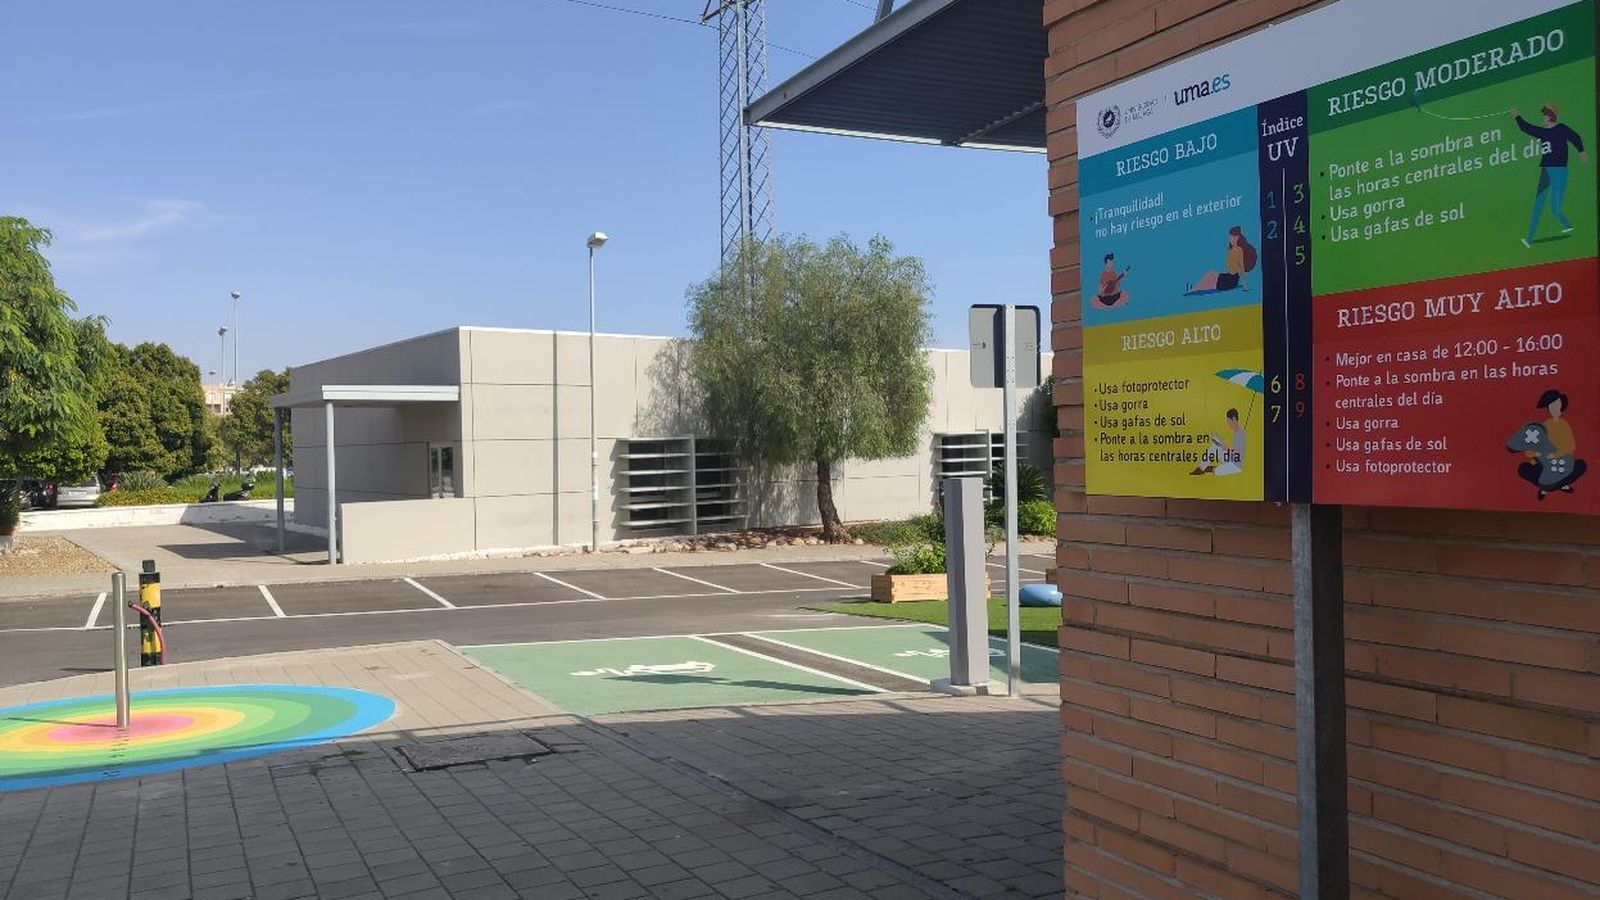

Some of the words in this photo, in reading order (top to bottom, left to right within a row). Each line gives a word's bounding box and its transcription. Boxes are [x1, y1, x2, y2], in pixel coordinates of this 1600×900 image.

[1327, 78, 1406, 117] RIESGO
[1414, 28, 1565, 94] MODERADO
[1174, 74, 1230, 105] uma.es
[1262, 116, 1303, 137] Índice
[1115, 148, 1169, 177] RIESGO
[1175, 134, 1217, 160] BAJO
[1267, 137, 1299, 161] UV
[1328, 156, 1369, 181] Ponte
[1375, 157, 1384, 170] a
[1390, 150, 1404, 167] la
[1410, 135, 1473, 161] sombra
[1480, 128, 1502, 145] en
[1329, 183, 1351, 201] las
[1356, 174, 1400, 195] horas
[1405, 155, 1483, 185] centrales
[1488, 144, 1516, 166] del
[1522, 137, 1552, 159] día
[1267, 191, 1276, 209] 1
[1293, 184, 1304, 204] 3
[1095, 192, 1164, 225] ¡Tranquilidad!
[1095, 227, 1107, 238] no
[1110, 223, 1127, 240] hay
[1131, 215, 1163, 231] riesgo
[1166, 212, 1178, 221] en
[1182, 204, 1192, 219] el
[1196, 195, 1242, 215] exterior
[1330, 204, 1358, 221] Usa
[1363, 196, 1405, 218] gorra
[1266, 220, 1278, 240] 2
[1293, 215, 1306, 234] 4
[1330, 225, 1358, 242] Usa
[1364, 215, 1409, 240] gafas
[1414, 209, 1434, 228] de
[1440, 202, 1465, 222] sol
[1295, 245, 1305, 265] 5
[1337, 301, 1416, 329] RIESGO
[1424, 292, 1485, 318] MUY
[1495, 281, 1563, 310] ALTO
[1121, 330, 1175, 351] RIESGO
[1181, 324, 1221, 345] ALTO
[1336, 352, 1372, 368] Mejor
[1376, 352, 1392, 363] en
[1396, 349, 1427, 362] casa
[1432, 345, 1449, 360] de
[1454, 339, 1498, 358] 12:00
[1516, 333, 1563, 353] 16:00
[1271, 374, 1281, 393] 6
[1295, 373, 1305, 390] 8
[1336, 374, 1370, 388] Ponte
[1373, 375, 1382, 386] a
[1386, 371, 1399, 385] la
[1403, 367, 1456, 384] sombra
[1460, 368, 1478, 380] en
[1484, 364, 1507, 379] las
[1512, 362, 1558, 377] horas
[1099, 382, 1118, 395] Usa
[1122, 379, 1190, 395] fotoprotector
[1100, 400, 1118, 412] Usa
[1122, 401, 1148, 413] gorra
[1295, 401, 1305, 418] 9
[1335, 393, 1393, 409] centrales
[1397, 392, 1418, 406] del
[1422, 391, 1443, 405] día
[1100, 416, 1118, 427] Usa
[1122, 415, 1150, 430] gafas
[1154, 415, 1166, 427] de
[1170, 415, 1186, 426] sol
[1271, 405, 1281, 423] 7
[1336, 417, 1360, 430] Usa
[1364, 418, 1399, 432] gorra
[1100, 433, 1126, 445] Ponte
[1129, 436, 1135, 444] a
[1138, 432, 1149, 444] la
[1152, 432, 1192, 444] sombra
[1196, 434, 1210, 444] en
[1336, 438, 1360, 451] Usa
[1364, 437, 1401, 453] gafas
[1406, 437, 1422, 450] de
[1427, 437, 1448, 450] sol
[1100, 450, 1114, 461] las
[1118, 450, 1145, 462] horas
[1149, 450, 1198, 462] centrales
[1201, 450, 1219, 463] del
[1223, 449, 1241, 463] día
[1336, 459, 1360, 472] Usa
[1364, 459, 1452, 475] fotoprotector
